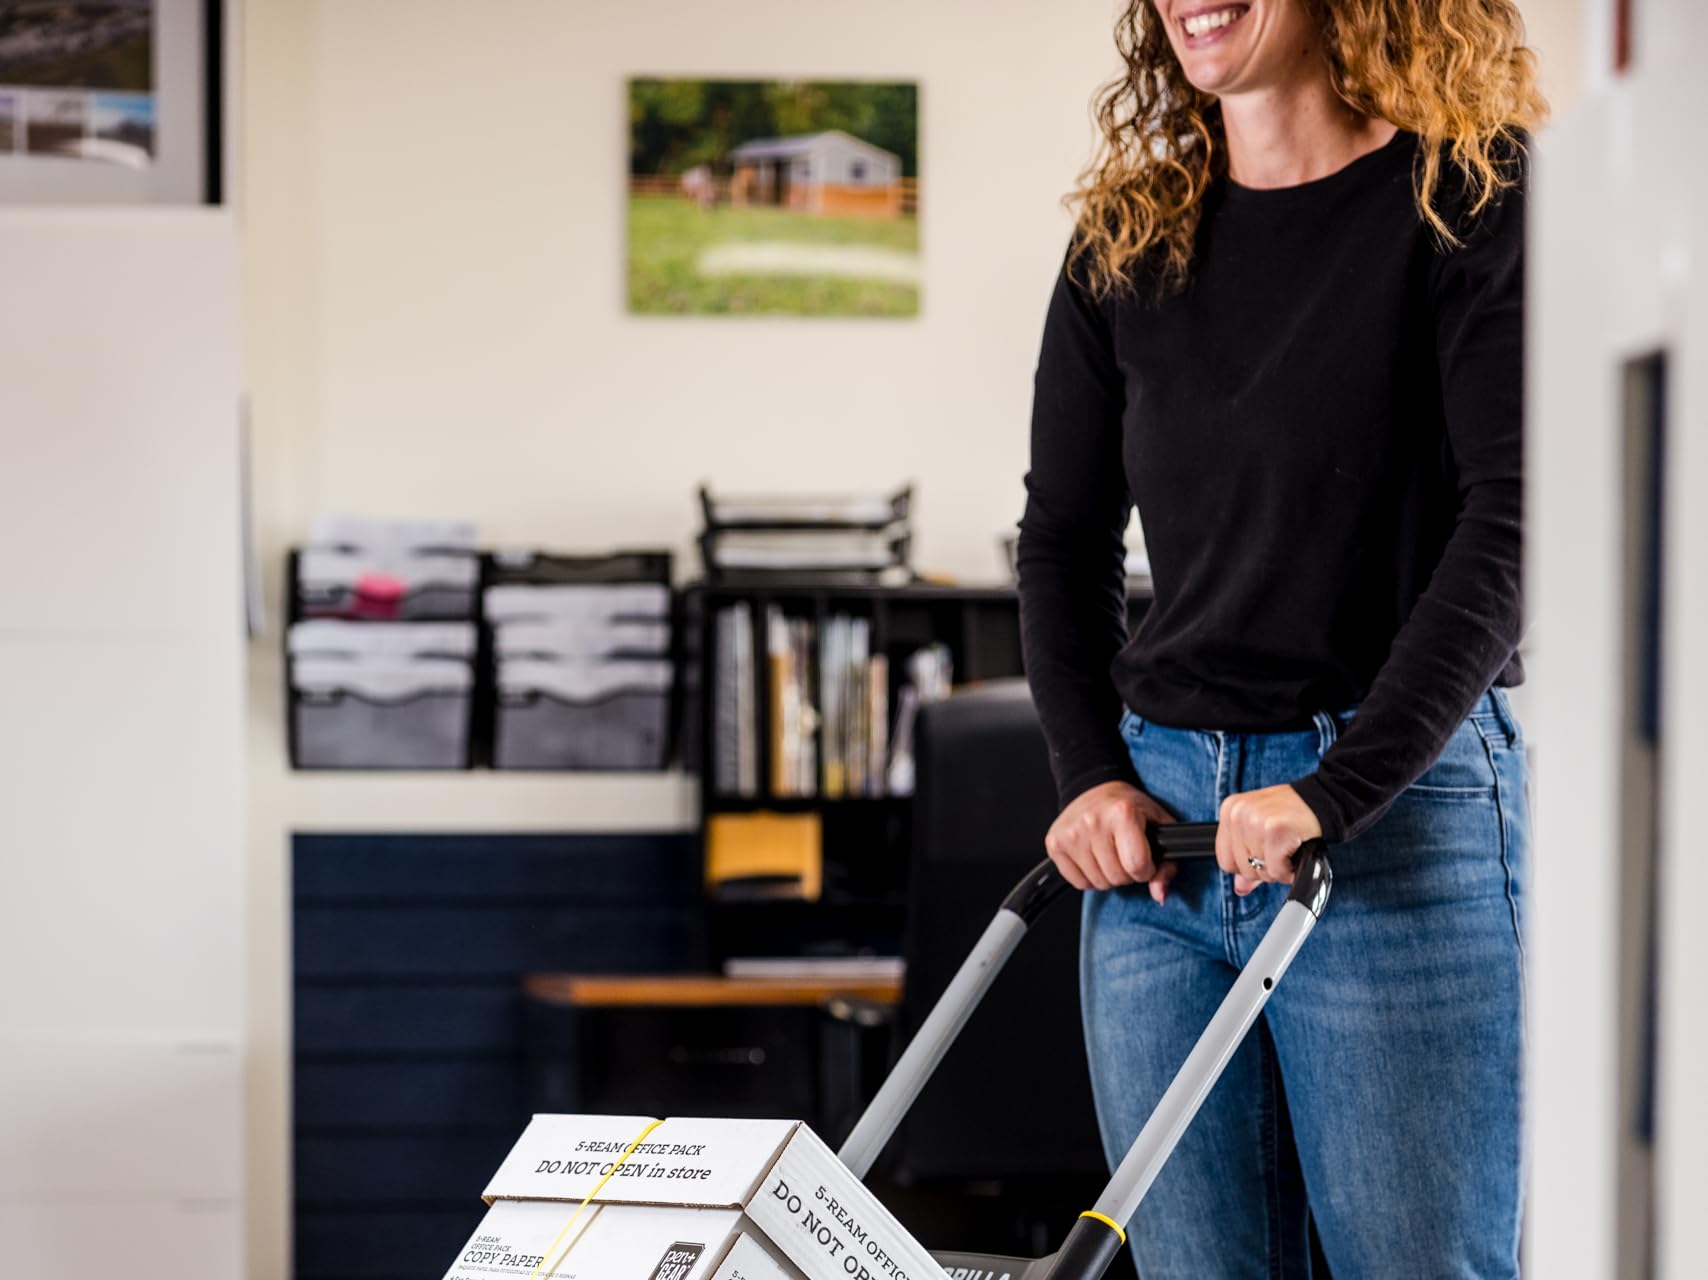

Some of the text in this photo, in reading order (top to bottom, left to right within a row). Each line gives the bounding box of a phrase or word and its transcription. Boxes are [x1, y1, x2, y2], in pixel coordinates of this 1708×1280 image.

[575, 1141, 624, 1153] 5-REAM
[668, 1144, 706, 1156] PACK
[535, 1160, 712, 1180] DO NOT OPEN in store
[772, 1180, 802, 1214] DO
[801, 1210, 845, 1257] NOT
[815, 1186, 868, 1245] 5-REAM
[463, 1250, 544, 1268] COPY PAPER
[661, 1251, 696, 1268] pen+
